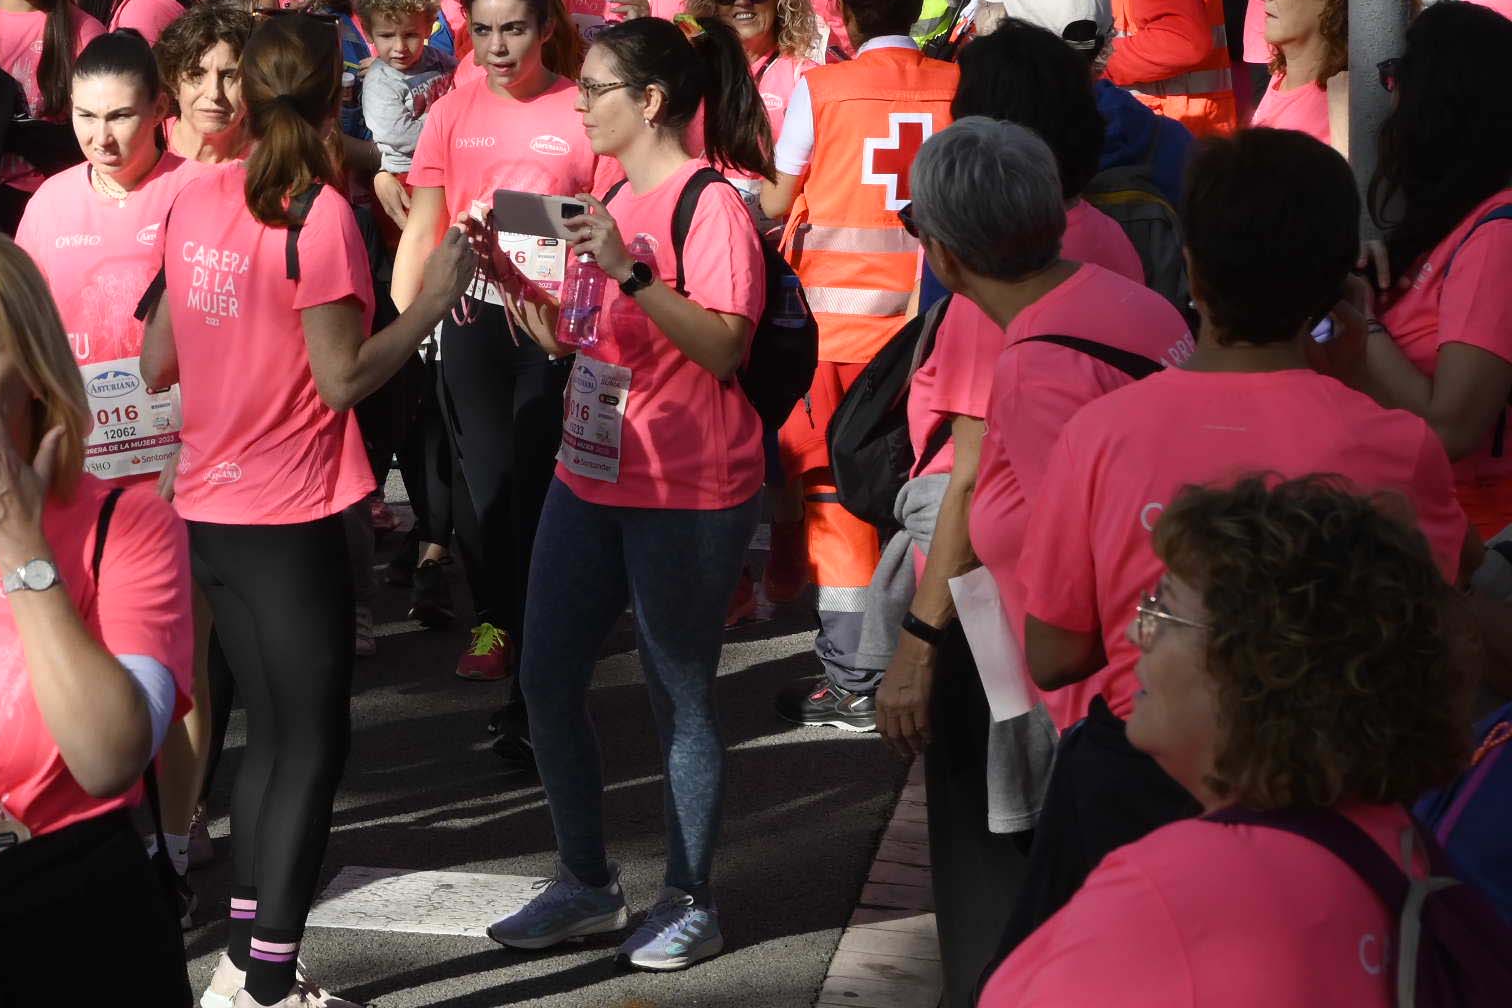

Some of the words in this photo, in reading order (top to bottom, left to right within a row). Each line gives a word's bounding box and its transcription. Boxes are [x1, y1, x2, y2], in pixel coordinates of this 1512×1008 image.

[455, 136, 495, 150] OYSHO
[214, 273, 236, 296] LA
[187, 290, 238, 318] MUJER
[90, 380, 136, 394] ASTURIANA
[96, 404, 139, 426] 016
[103, 426, 137, 440] 12062
